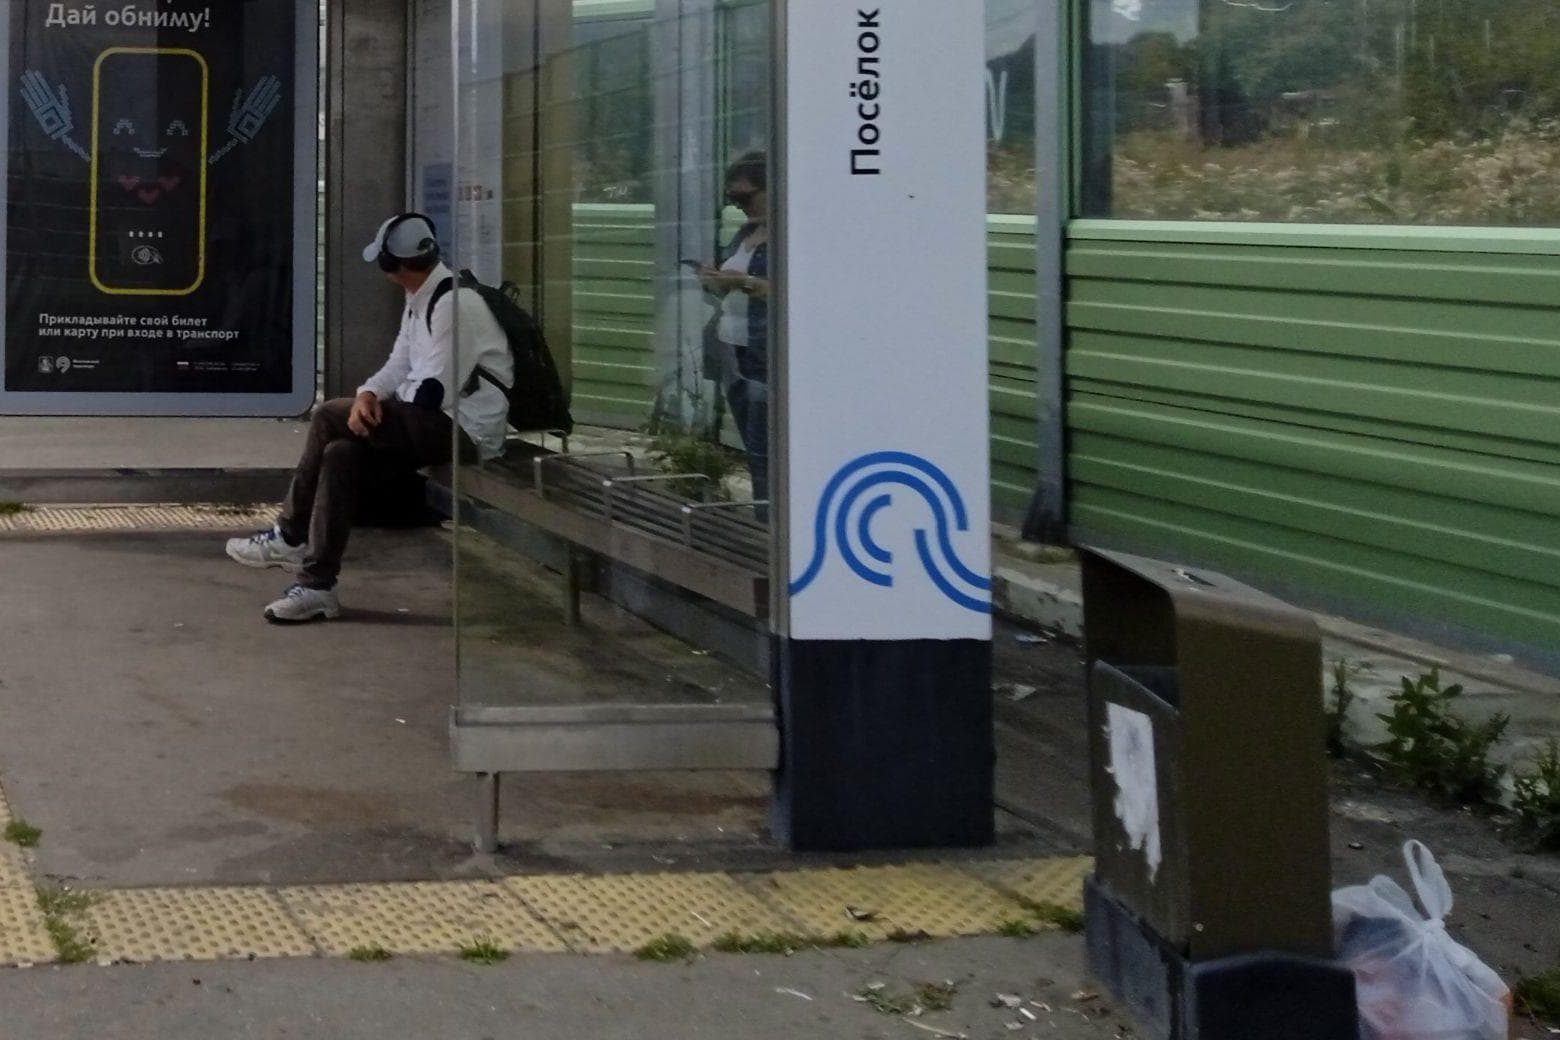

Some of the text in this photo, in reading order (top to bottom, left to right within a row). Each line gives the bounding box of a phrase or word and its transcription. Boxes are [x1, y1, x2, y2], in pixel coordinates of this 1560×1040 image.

[45, 3, 211, 33] Дай обниму!
[850, 8, 880, 175] Посёлок
[39, 313, 208, 329] Прикладывайте свой билет
[38, 328, 240, 342] или карту при входе в транспорт
